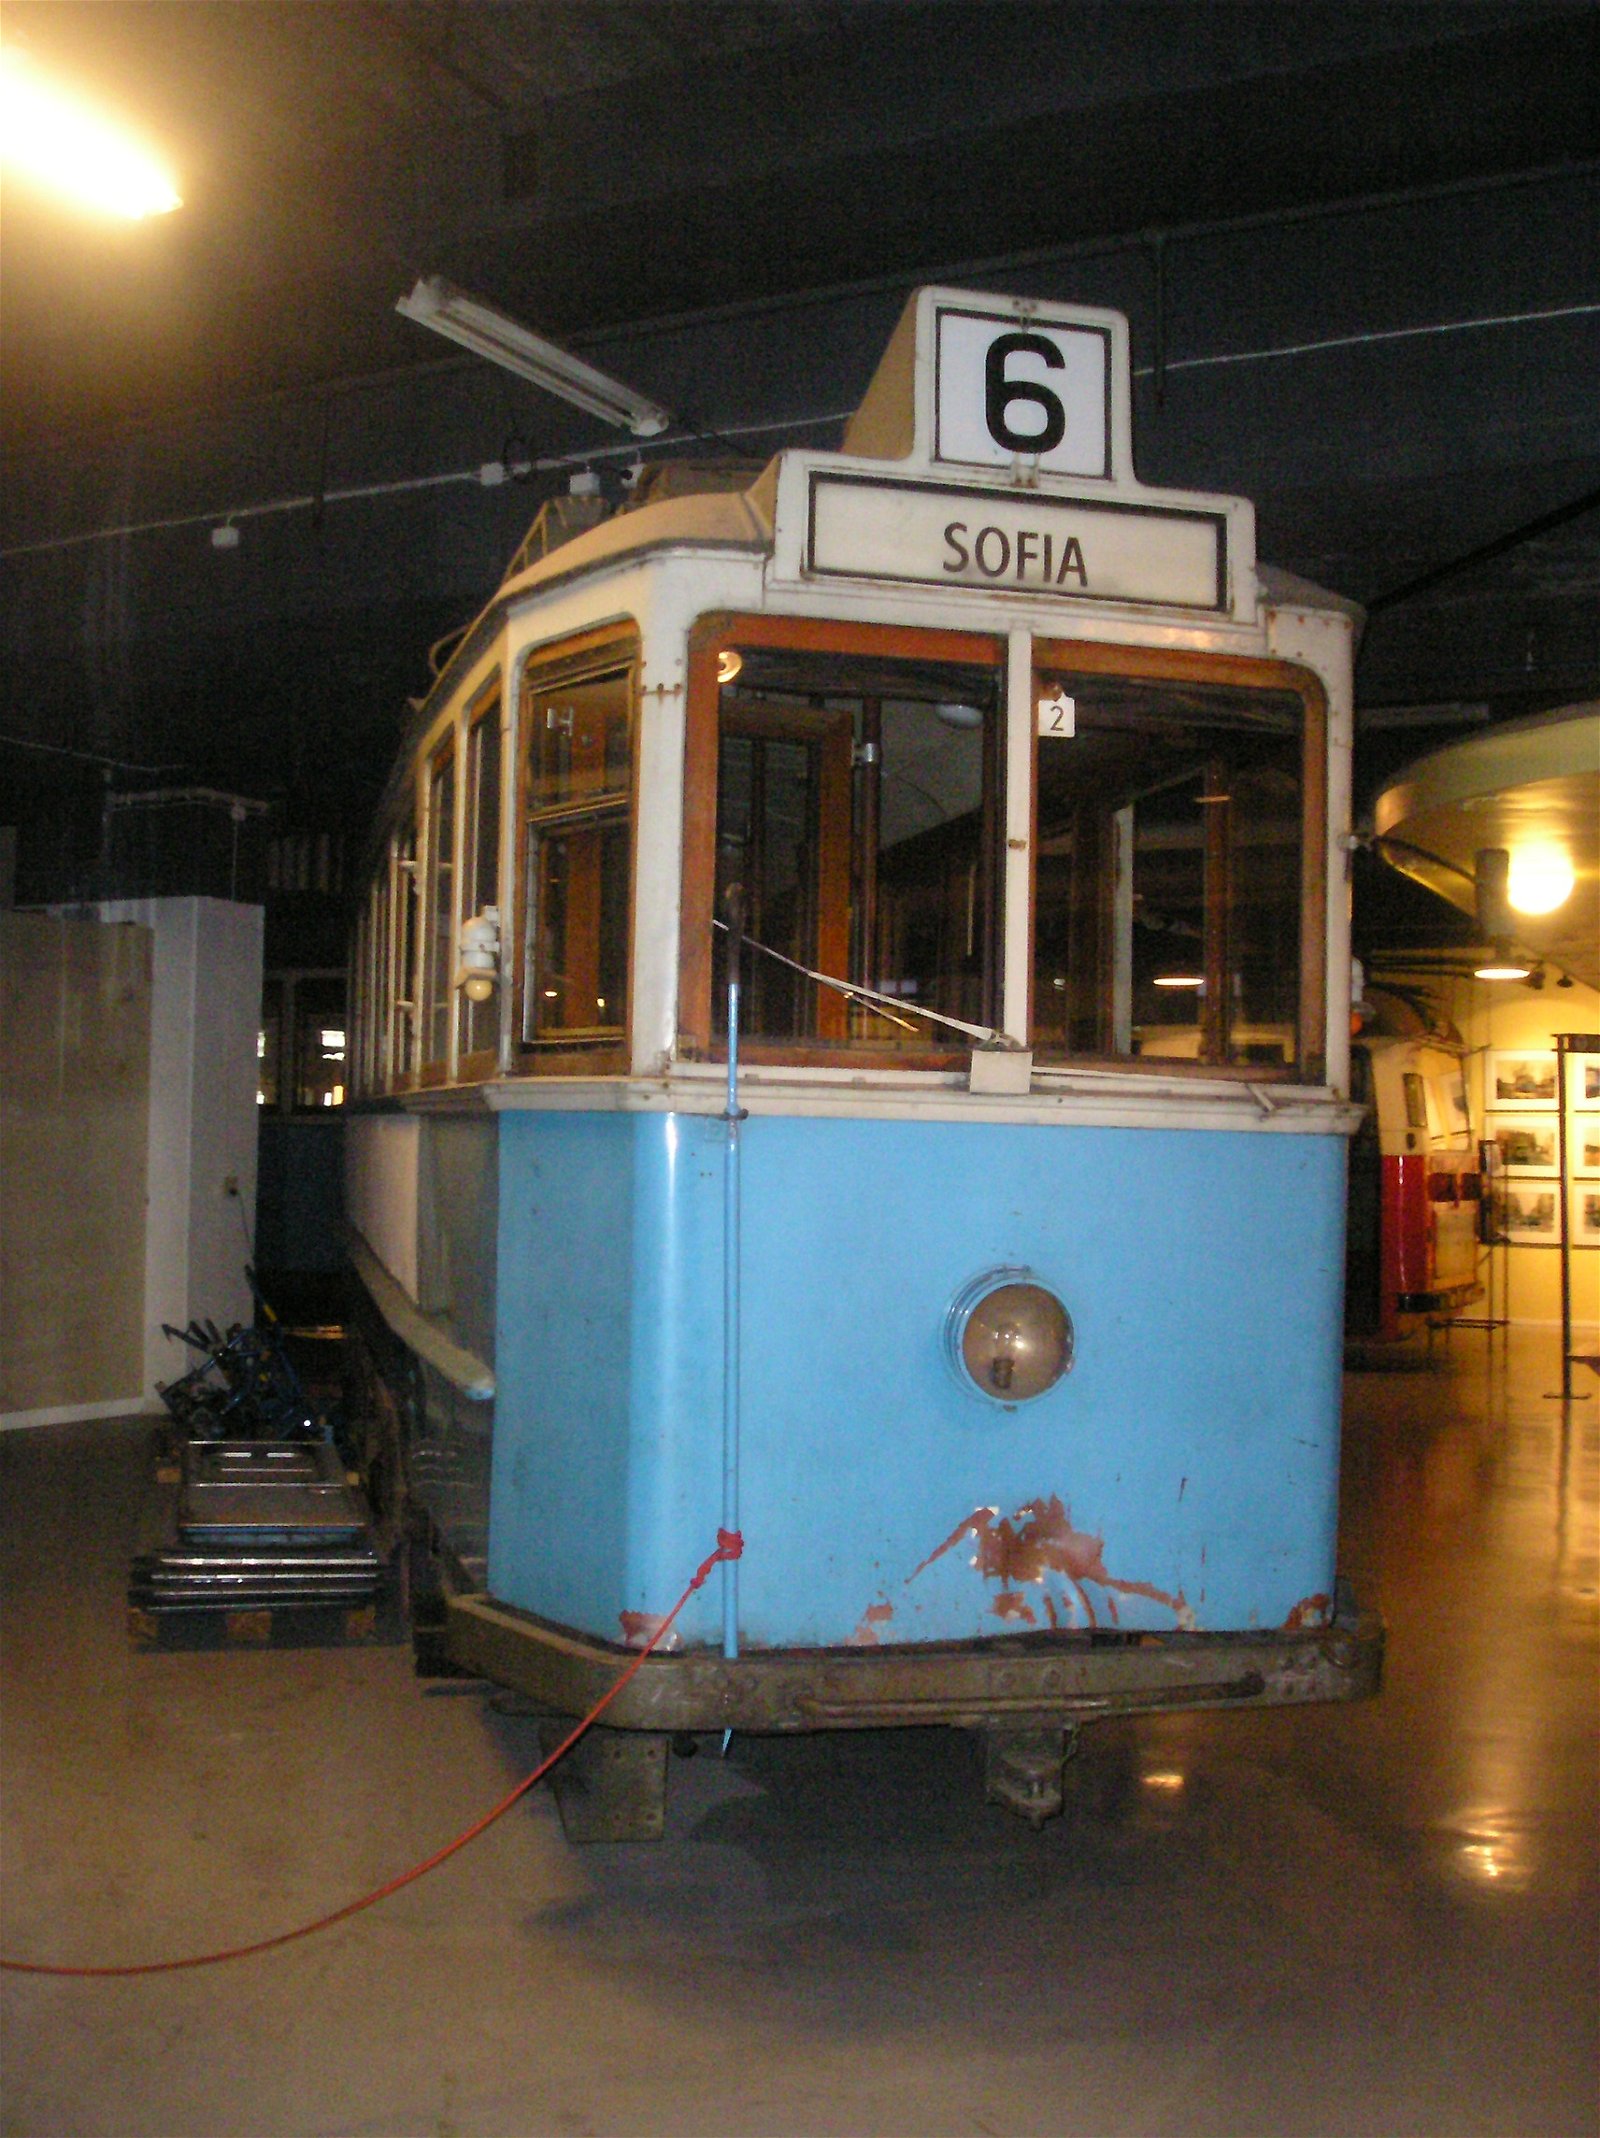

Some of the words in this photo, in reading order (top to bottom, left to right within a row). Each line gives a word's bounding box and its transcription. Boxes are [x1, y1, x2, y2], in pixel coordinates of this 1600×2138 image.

[986, 332, 1066, 455] 6
[942, 521, 1089, 588] SOFIA
[1049, 704, 1065, 732] 2
